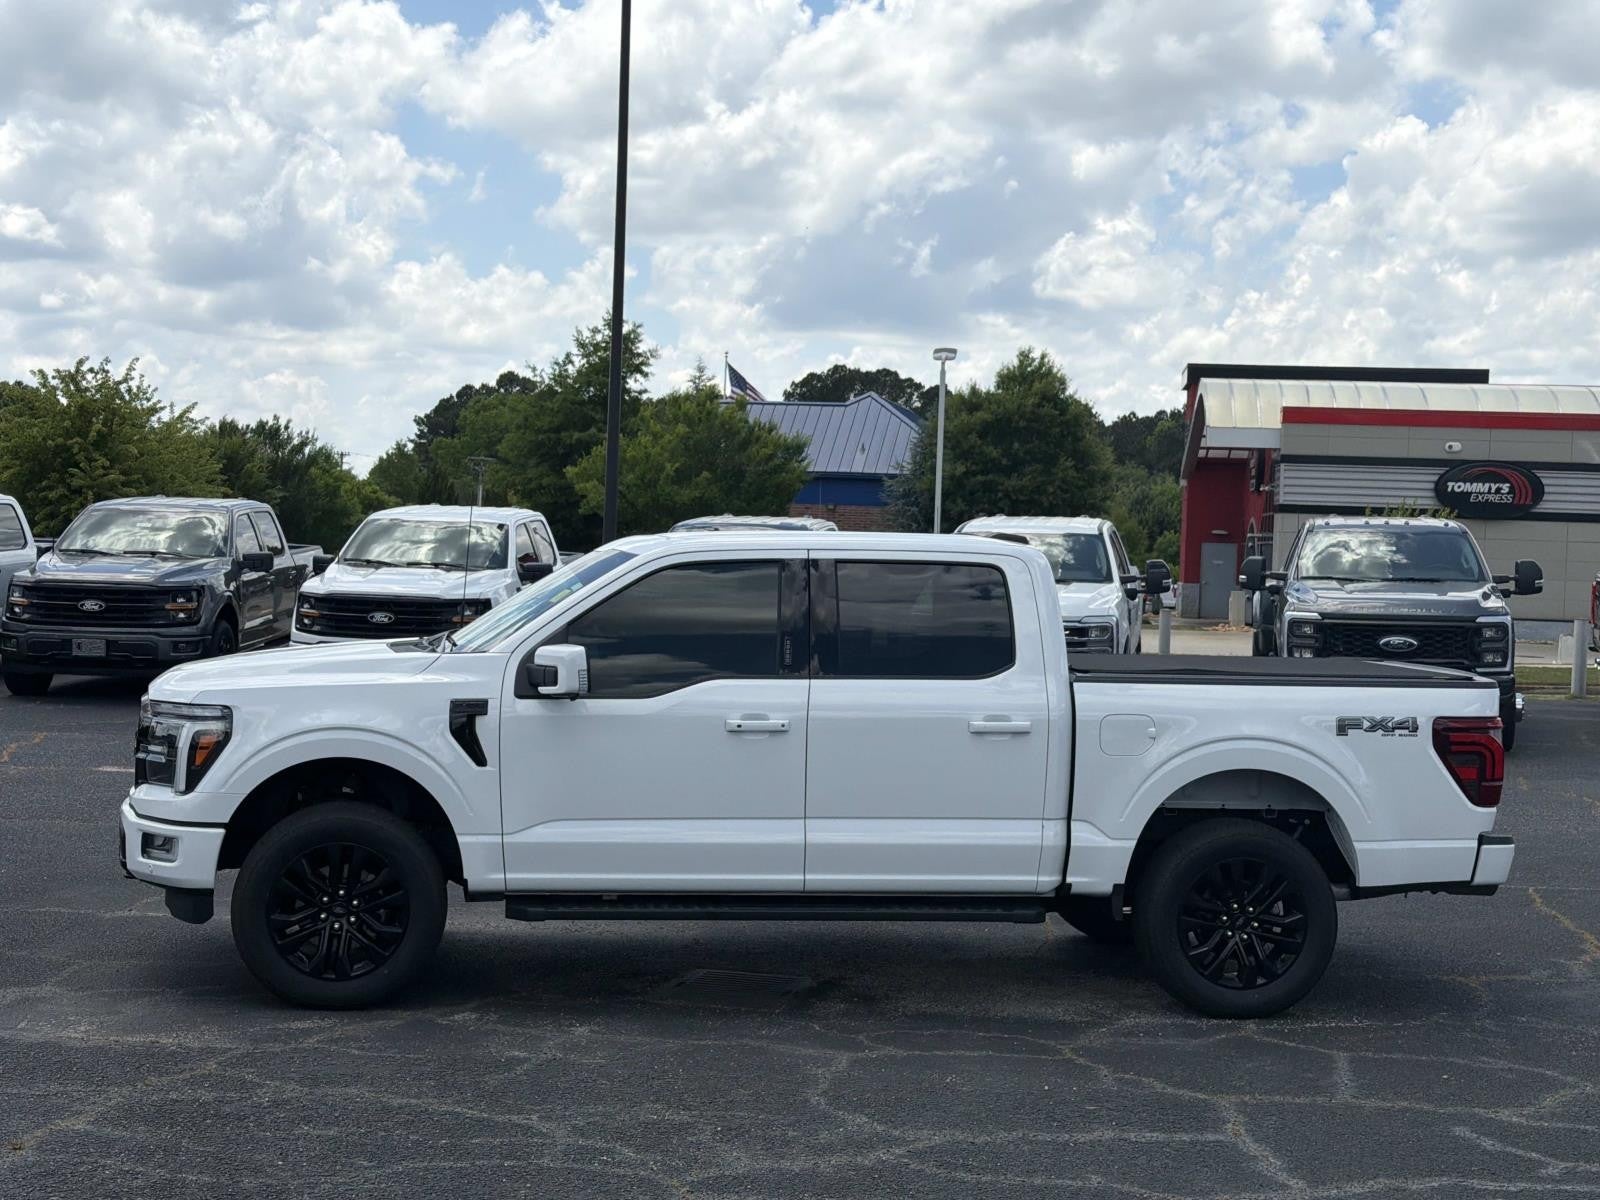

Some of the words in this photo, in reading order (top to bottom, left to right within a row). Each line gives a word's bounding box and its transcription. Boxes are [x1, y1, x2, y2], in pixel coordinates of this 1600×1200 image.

[1446, 481, 1511, 493] TOMMY'S
[1469, 493, 1514, 503] EXPRESS
[1336, 716, 1418, 736] FX4
